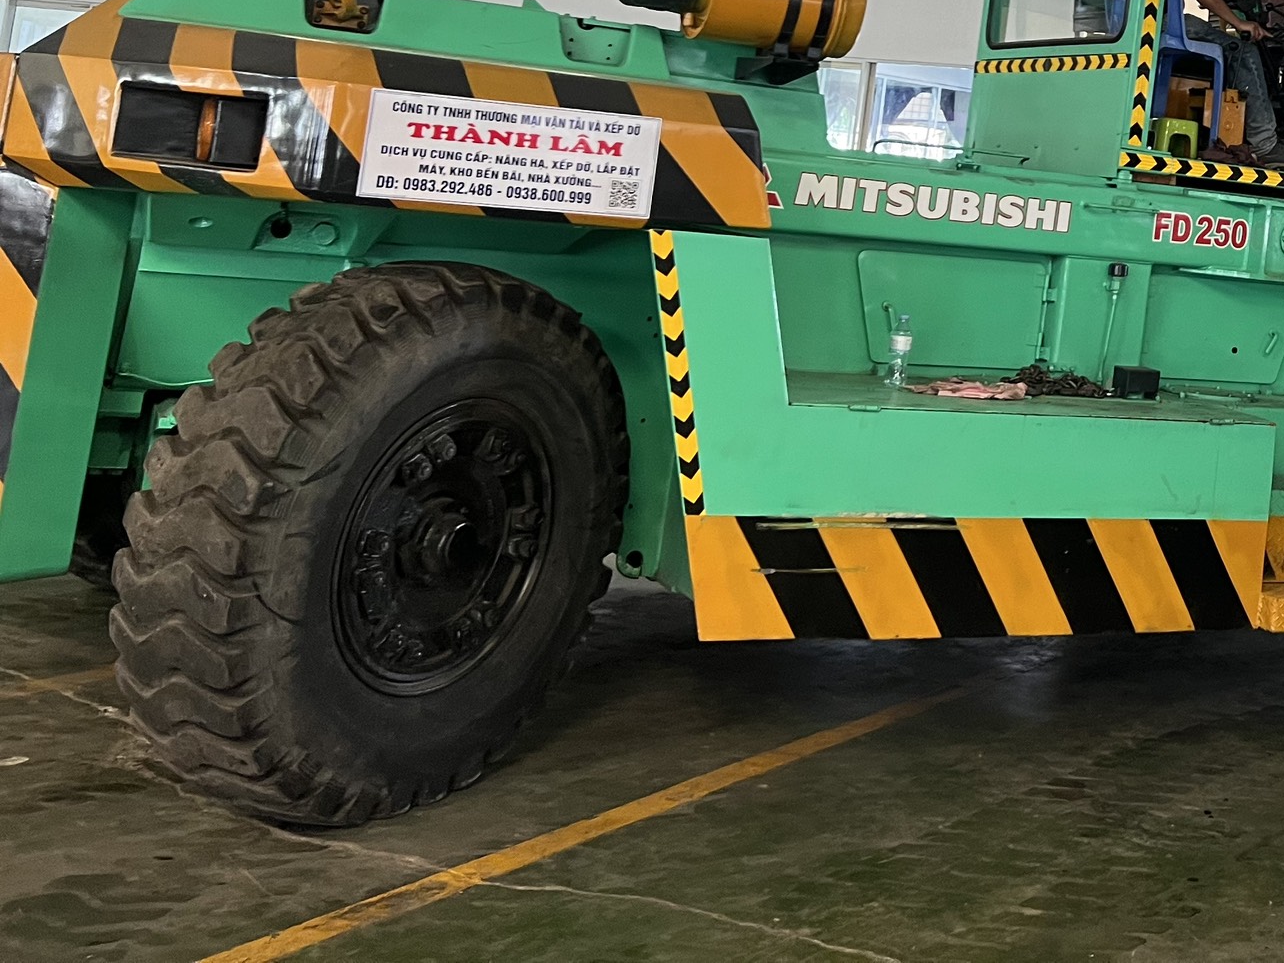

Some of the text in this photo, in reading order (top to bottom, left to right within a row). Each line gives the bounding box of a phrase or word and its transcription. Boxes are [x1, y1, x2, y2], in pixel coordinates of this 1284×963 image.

[392, 100, 423, 114] CÔNG
[427, 105, 440, 116] TY
[443, 106, 471, 119] TNHH
[475, 110, 517, 124] THƯƠNG
[520, 114, 541, 127] MẠI
[545, 116, 566, 130] VẬN
[569, 117, 585, 131] TẢI
[588, 119, 601, 132] VÀ
[604, 121, 624, 134] XẾP
[407, 122, 624, 157] THÀNH LÂM
[380, 145, 409, 157] DỊCH
[412, 148, 427, 160] VỤ
[430, 149, 462, 161] CUNG
[465, 151, 492, 164] CẤP:
[495, 155, 526, 167] NÂNG
[552, 158, 573, 171] XẾP
[619, 166, 640, 178] ĐẶT
[418, 164, 446, 176] MÁY,
[449, 166, 473, 177] KHO
[476, 167, 499, 180] BẾN
[527, 172, 551, 184] NHÀ
[376, 175, 398, 189] DĐ:
[403, 177, 492, 197] 0983.292.486
[506, 185, 592, 205] 0938.600.999
[793, 171, 1073, 233] MITSUBISHI
